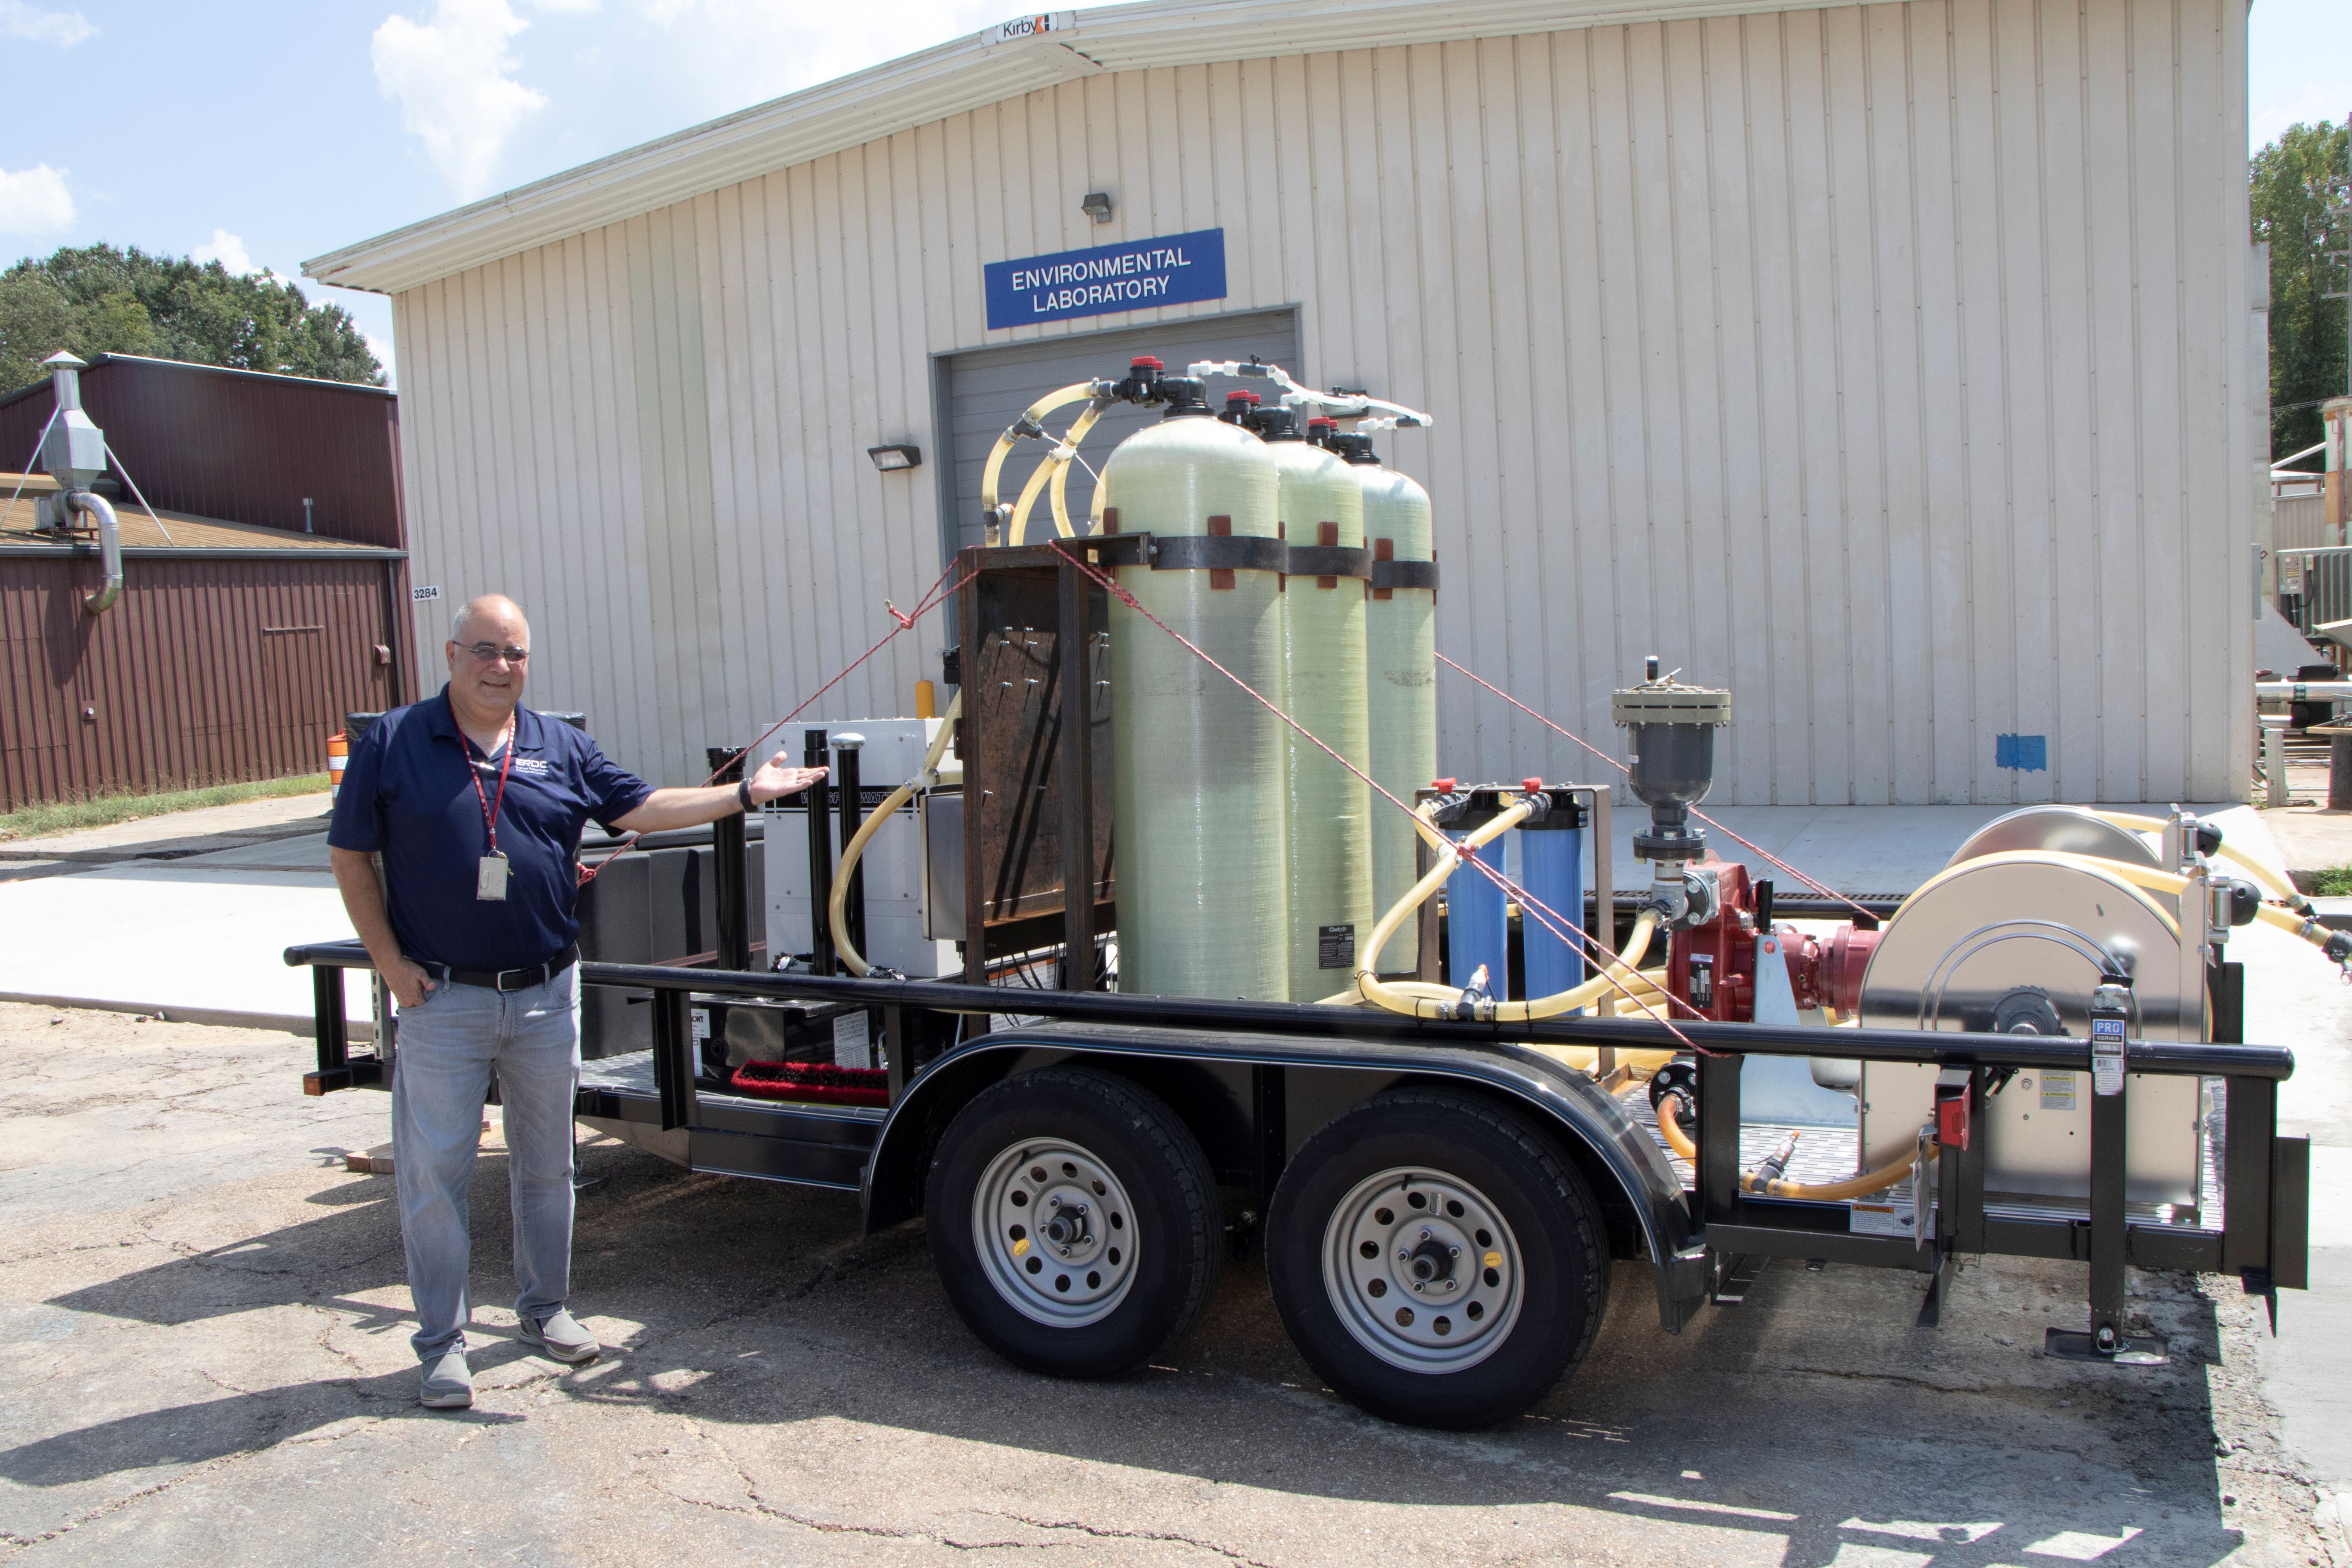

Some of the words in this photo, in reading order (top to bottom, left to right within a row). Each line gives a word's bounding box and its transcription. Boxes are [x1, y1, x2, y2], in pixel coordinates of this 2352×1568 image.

[1004, 19, 1038, 38] Kirby
[1012, 247, 1191, 291] ENVIRONMENTAL
[1033, 275, 1170, 312] LABORATORY
[414, 587, 438, 599] 3284
[515, 758, 547, 769] ERDC
[2097, 1022, 2120, 1033] PRO
